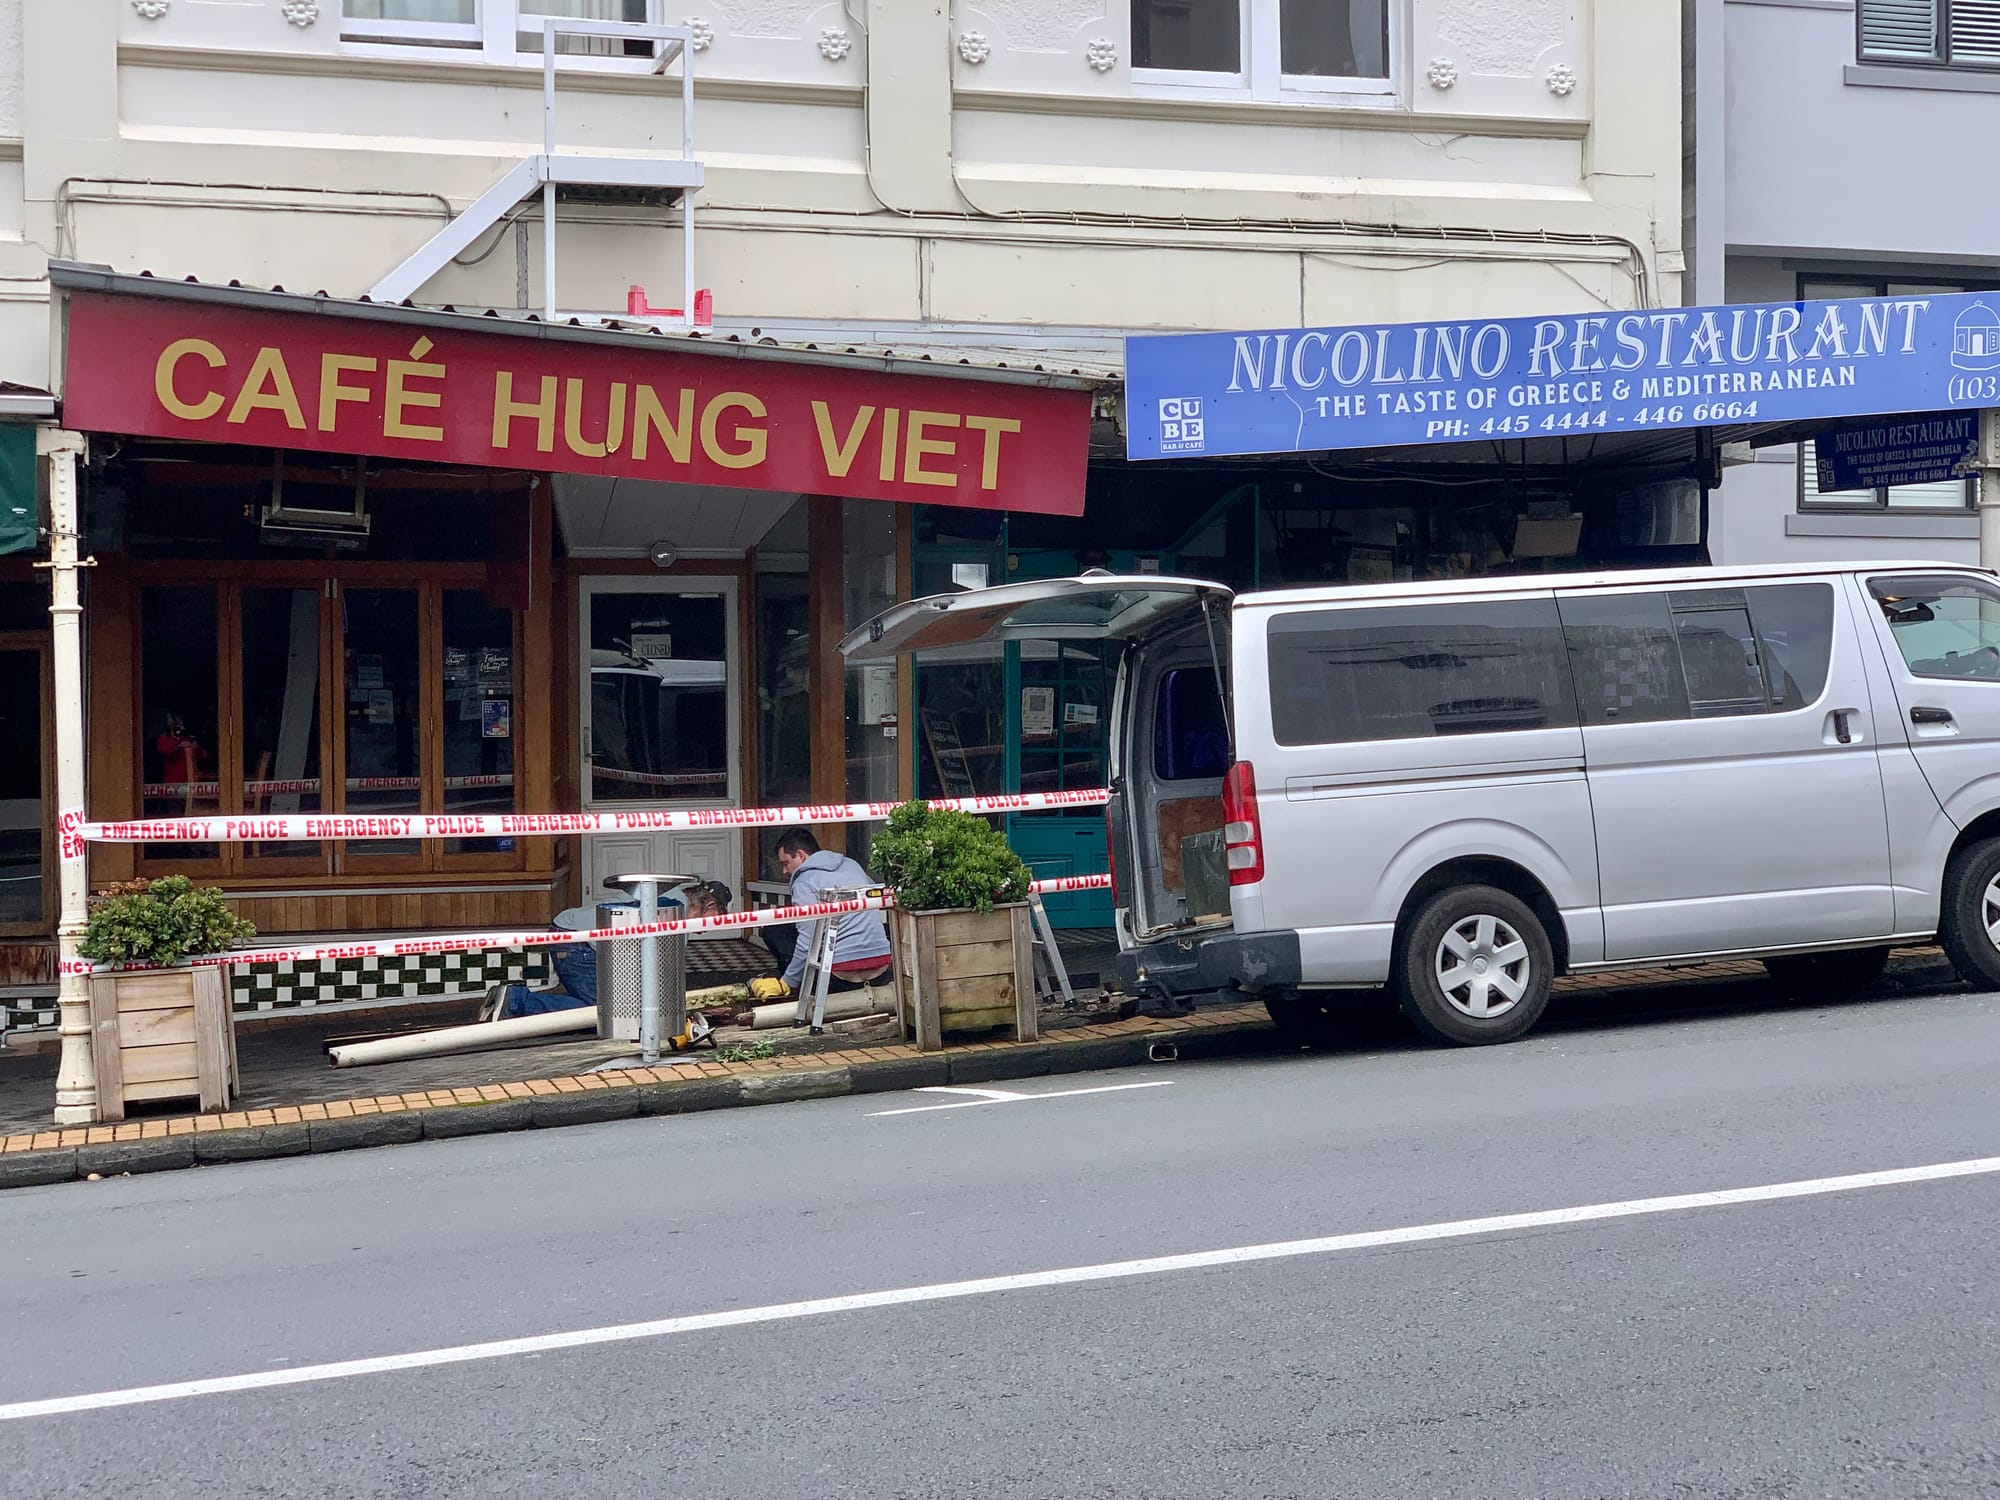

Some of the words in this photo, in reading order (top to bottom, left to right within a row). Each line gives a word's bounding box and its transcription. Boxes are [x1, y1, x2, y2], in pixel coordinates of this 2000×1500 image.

[1225, 323, 1511, 394] NICOLINO
[1526, 300, 1932, 381] RESTAURANT
[1315, 394, 1367, 419] THE
[1376, 388, 1458, 414] TASTE
[1465, 387, 1498, 410] OF
[1507, 380, 1603, 408] GREECE
[1612, 378, 1631, 401] &
[1641, 365, 1857, 399] MEDITERRANEAN
[155, 335, 446, 442] CAFÉ
[491, 371, 768, 470] HUNG
[811, 400, 1022, 491] VIET
[1426, 419, 1470, 438] PH:
[1479, 415, 1530, 434] 445
[1539, 410, 1608, 431] 4444
[1632, 405, 1684, 424] 446
[1694, 401, 1759, 420] 6664
[1835, 428, 1886, 453] NICOLINO
[1888, 417, 1972, 447] RESTAURANT
[1847, 456, 1858, 466] THE
[1859, 454, 1876, 464] TASTE
[1876, 453, 1884, 463] OF
[1875, 474, 1889, 485] 445
[1890, 472, 1908, 483] 4444
[1914, 471, 1928, 481] 446
[1929, 469, 1948, 480] 6664
[249, 779, 319, 795] EMERGENCY
[102, 821, 212, 839] EMERGENCY
[226, 820, 289, 839] POLICE
[306, 817, 412, 837] EMERGENCY
[425, 816, 485, 834] POLICE
[501, 813, 601, 833] EMERGENCY
[613, 811, 673, 828] POLICE
[687, 806, 784, 826] EMERGENCY
[799, 803, 854, 821] POLICE
[976, 794, 1030, 809] POLICE
[1056, 873, 1109, 891] POLICE
